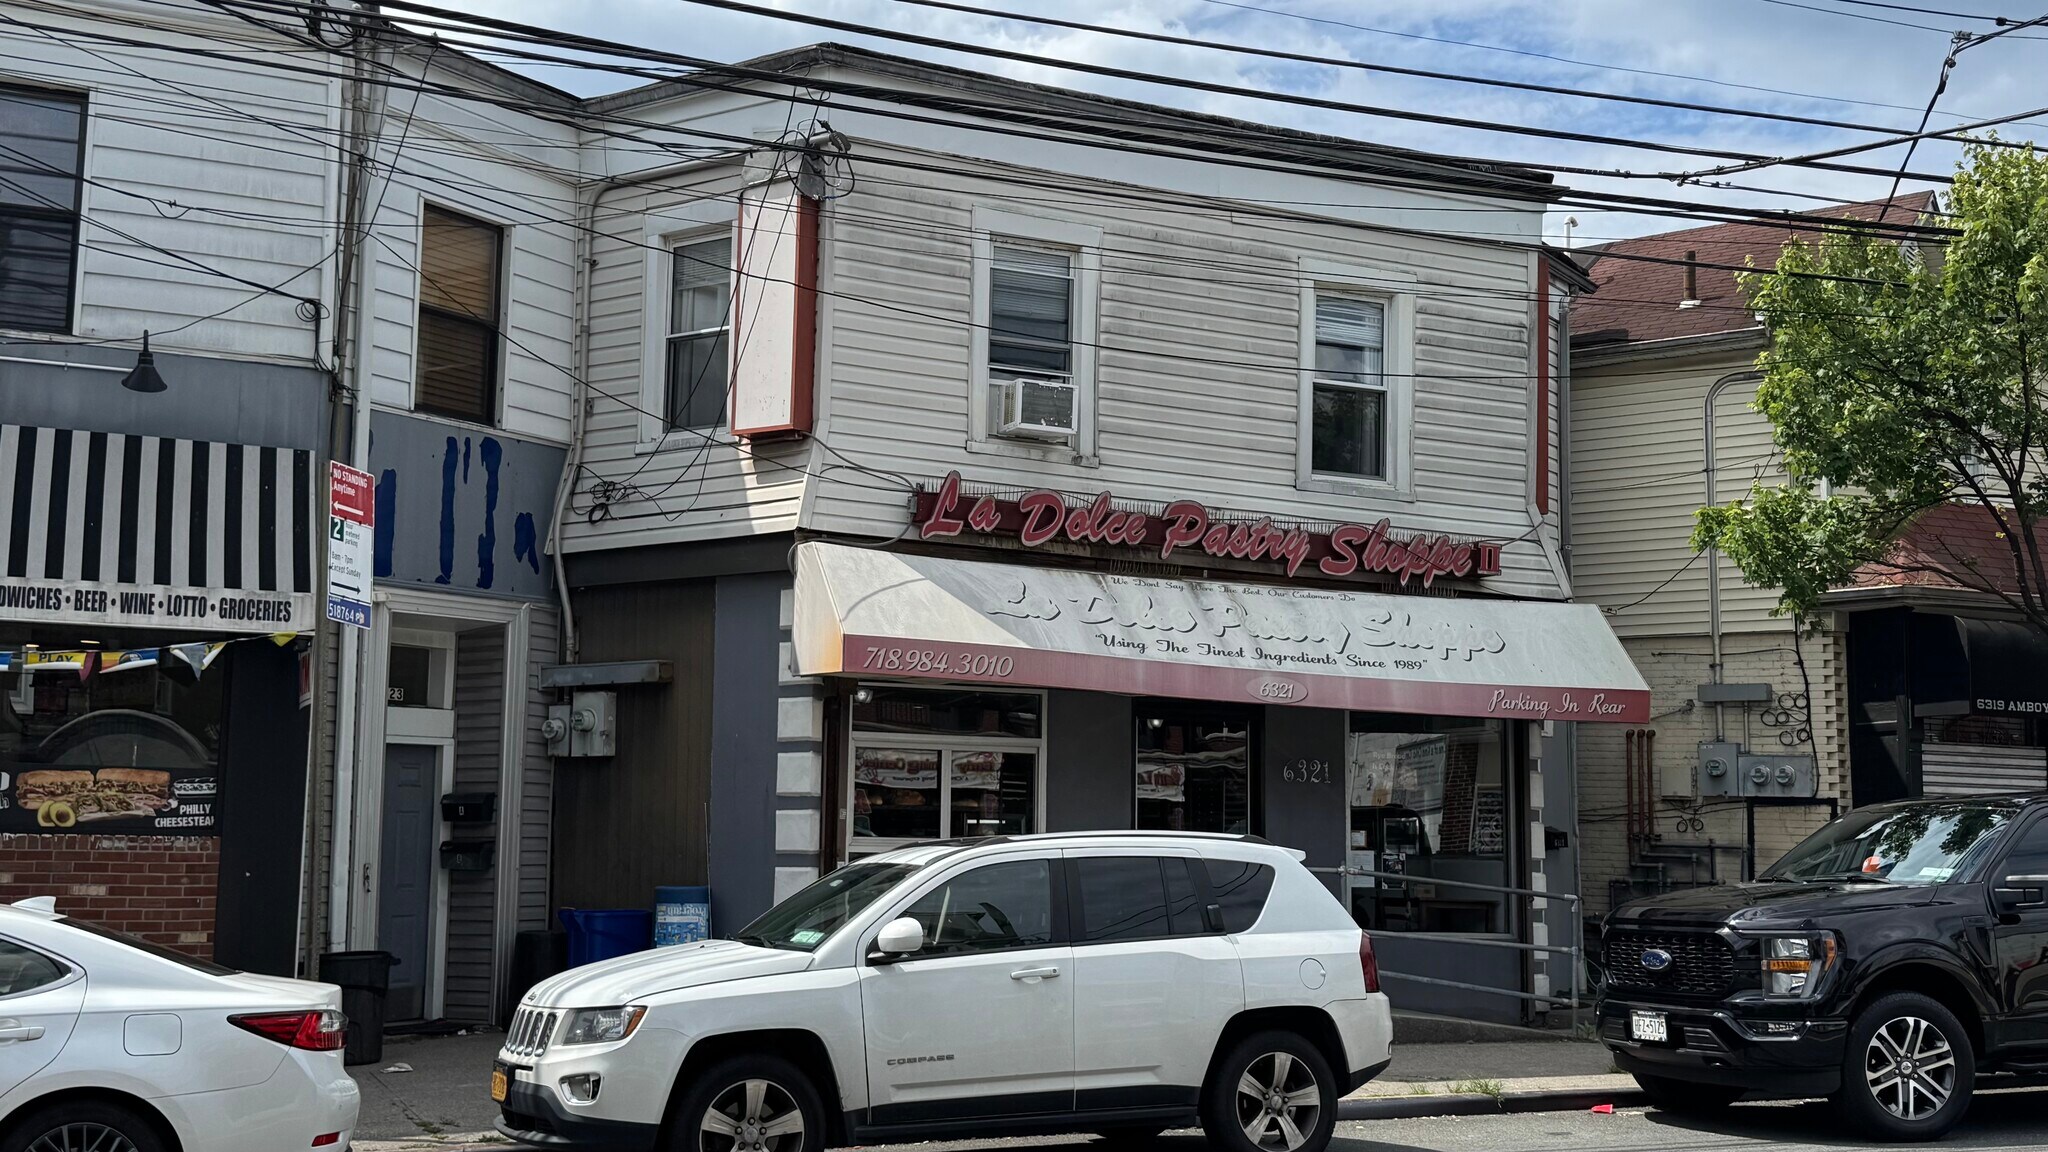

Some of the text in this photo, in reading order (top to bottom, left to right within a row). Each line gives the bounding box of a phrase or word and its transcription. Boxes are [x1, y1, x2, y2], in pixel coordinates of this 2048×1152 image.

[333, 468, 368, 488] NO STANDING
[333, 481, 356, 497] Anytime
[333, 518, 341, 539] 2
[919, 469, 1502, 589] La Dolce Pastry Shoppe II
[344, 538, 359, 549] parking
[346, 566, 361, 579] Sunday
[1111, 577, 1128, 585] We
[1133, 578, 1160, 588] Dont
[1164, 582, 1185, 592] Say
[1218, 584, 1238, 593] The
[1267, 589, 1287, 597] Our
[1292, 590, 1335, 600] Customers
[1337, 593, 1356, 602] Do
[74, 589, 108, 612] BEER
[120, 591, 155, 615] WINE
[166, 594, 207, 618] LOTTO
[218, 597, 292, 623] GROCERIES
[328, 603, 355, 623] 518764
[863, 646, 1015, 677] 718.984.3010
[1156, 639, 1190, 653] The
[1197, 643, 1246, 658] Finest
[1251, 647, 1338, 665] Ingredients
[1346, 653, 1387, 668] Since
[1259, 682, 1295, 699] 6321
[1487, 688, 1626, 720] Parking In Rear
[1976, 698, 2048, 713] 6319 AMBOY
[1283, 759, 1331, 783] 6321
[179, 803, 211, 815] PHILLY
[886, 1054, 955, 1066] COMPASS
